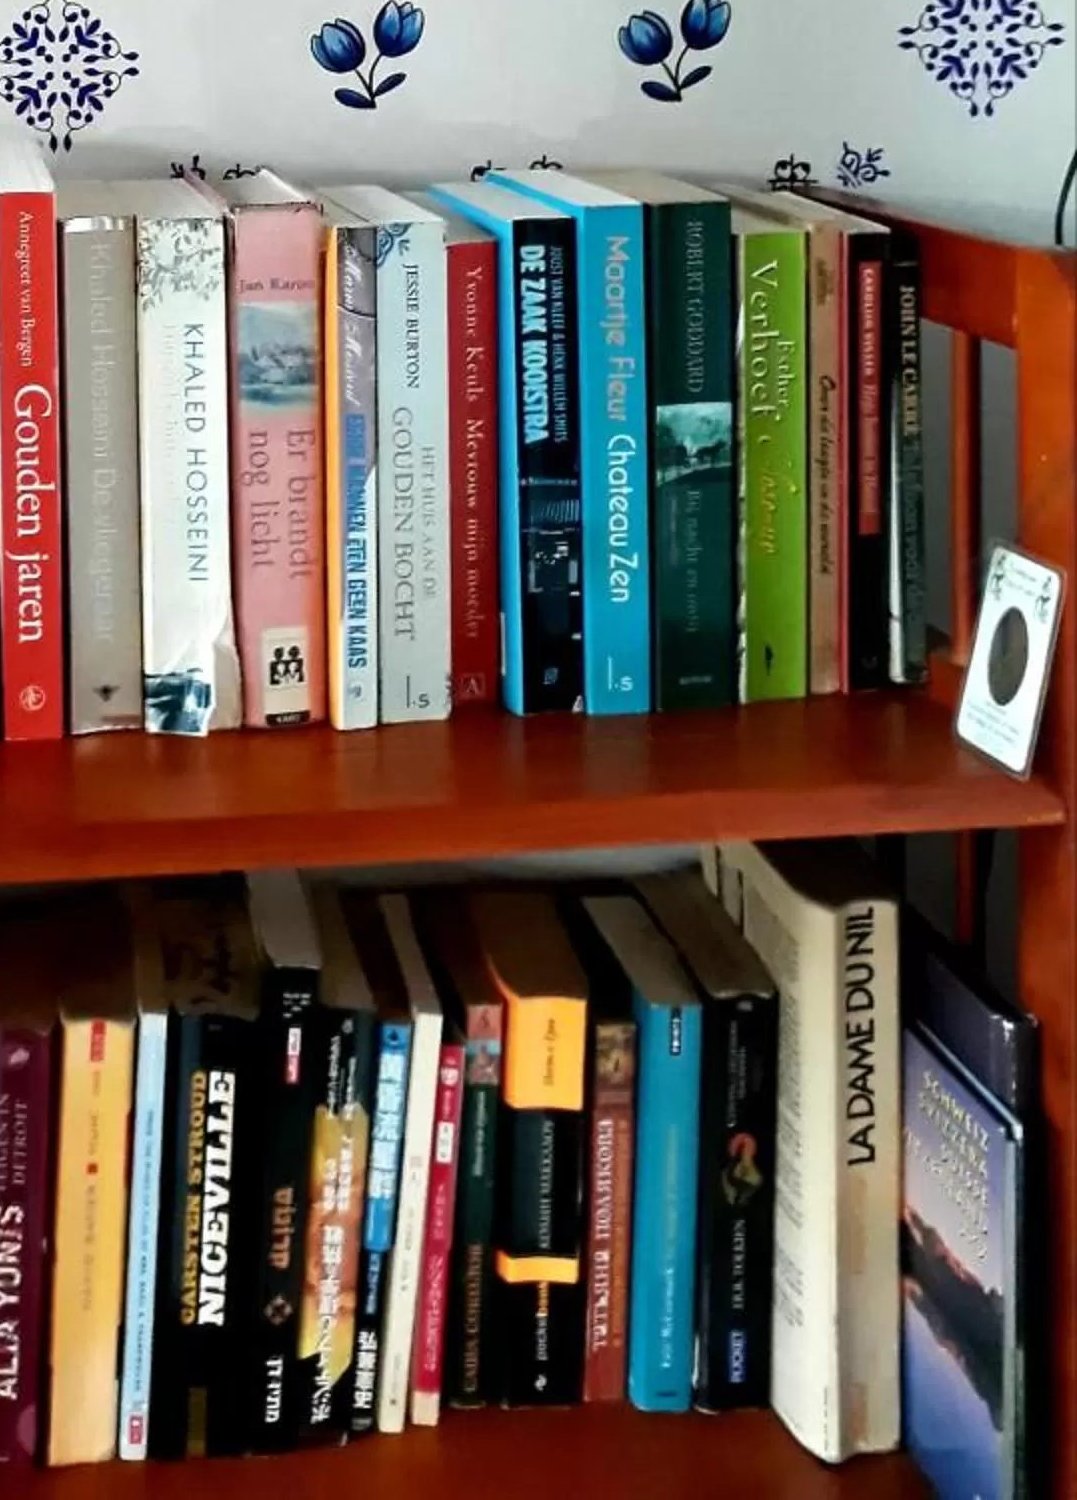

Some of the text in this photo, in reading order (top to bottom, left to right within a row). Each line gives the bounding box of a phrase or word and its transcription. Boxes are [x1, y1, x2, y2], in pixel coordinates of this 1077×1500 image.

[15, 211, 37, 368] Annegreet van Bergen
[403, 263, 421, 390] JESSIE BURTON
[466, 266, 484, 338] Yvonne
[520, 244, 550, 445] DE ZAAK KOOISTRA
[684, 220, 706, 393] ROBERT GODDARD
[748, 259, 781, 422] Verhoef
[898, 285, 918, 335] JOHN
[900, 340, 919, 366] LE
[466, 346, 484, 403] Keuls
[598, 234, 638, 604] Maartje Fleur Chateau Zen
[775, 340, 795, 408] Esther
[5, 384, 55, 644] Gouden jaren
[183, 323, 209, 582] KHALED HOSSEINI
[240, 431, 281, 569] nog licht
[285, 428, 316, 580] Er brandt
[390, 407, 417, 641] GOUDEN BOCHT
[466, 419, 484, 512] Mevrouw
[347, 538, 367, 573] ETEN
[348, 579, 368, 620] GEEN
[463, 518, 483, 562] mijn
[349, 625, 368, 669] KAAS
[845, 906, 875, 1167] LA DAME DU NIL
[179, 1069, 208, 1326] CARSTEN STROUD
[196, 1069, 235, 1327] NICEVILLE
[591, 1118, 615, 1352] ТАТЬЯНА ПОЛЯКОВА
